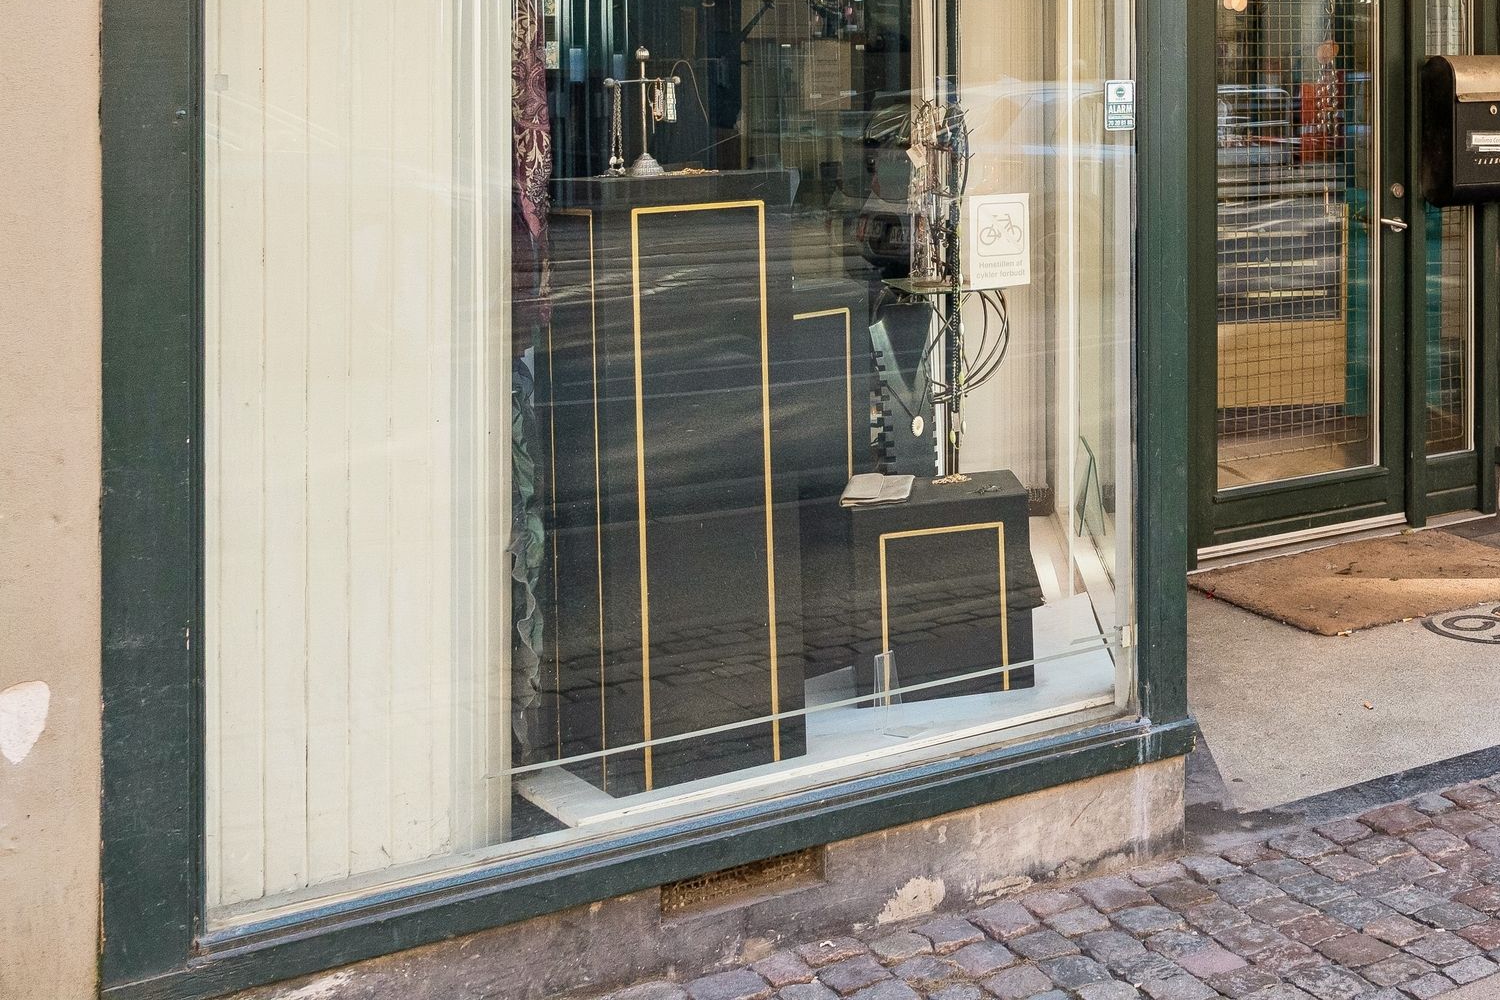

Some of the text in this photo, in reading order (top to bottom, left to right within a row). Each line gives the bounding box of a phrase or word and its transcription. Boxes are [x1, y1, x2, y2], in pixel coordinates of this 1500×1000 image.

[1108, 104, 1133, 114] ALARM
[978, 260, 1014, 269] Henstillen
[976, 269, 1025, 280] cykler forbudt
